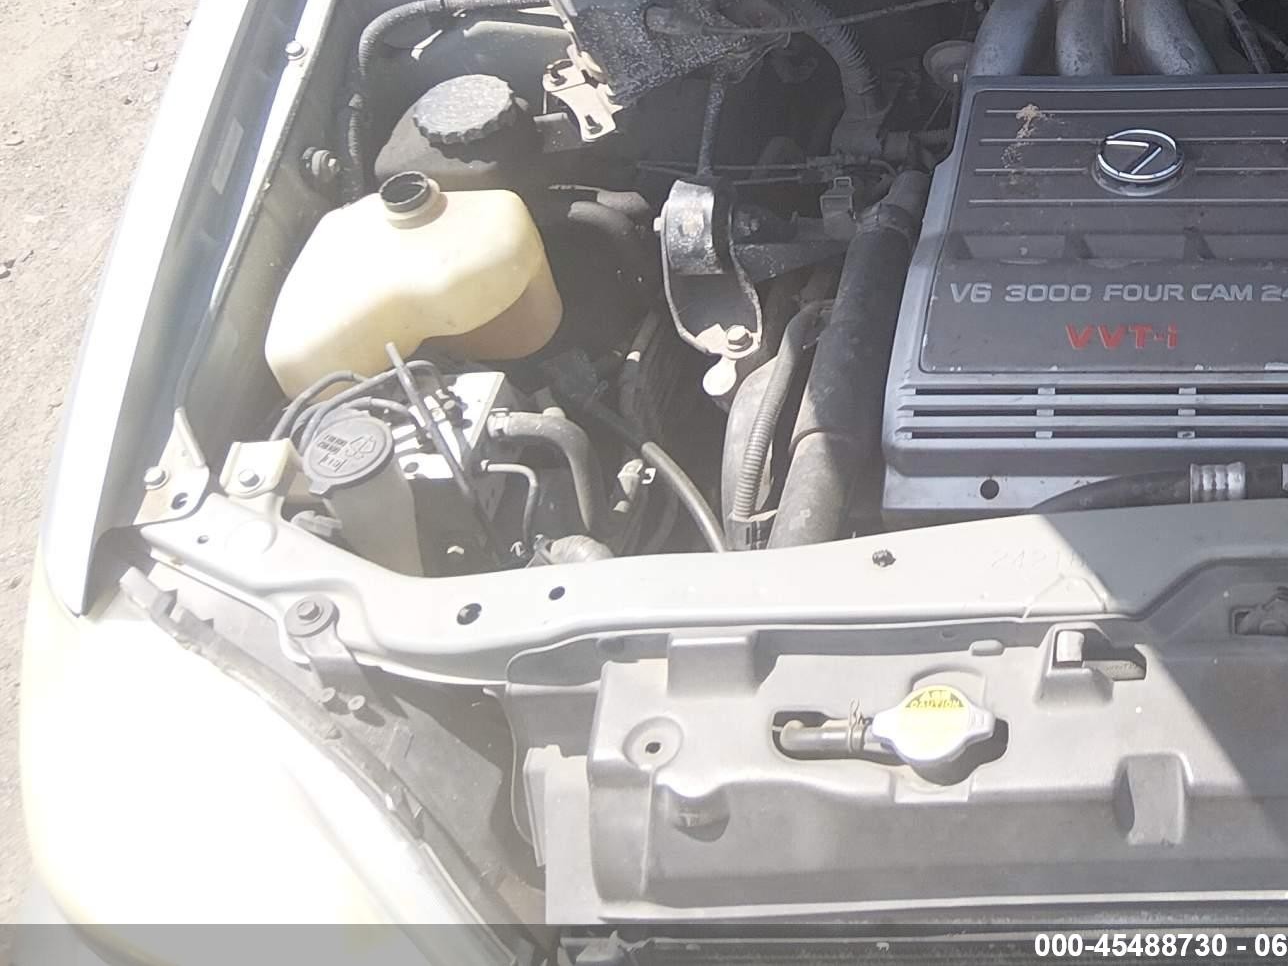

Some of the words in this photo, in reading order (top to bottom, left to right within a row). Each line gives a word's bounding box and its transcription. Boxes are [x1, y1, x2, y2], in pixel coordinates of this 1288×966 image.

[950, 283, 992, 303] V6
[1004, 284, 1092, 302] 3000
[1103, 284, 1185, 302] FOUR
[1191, 284, 1253, 301] CAM
